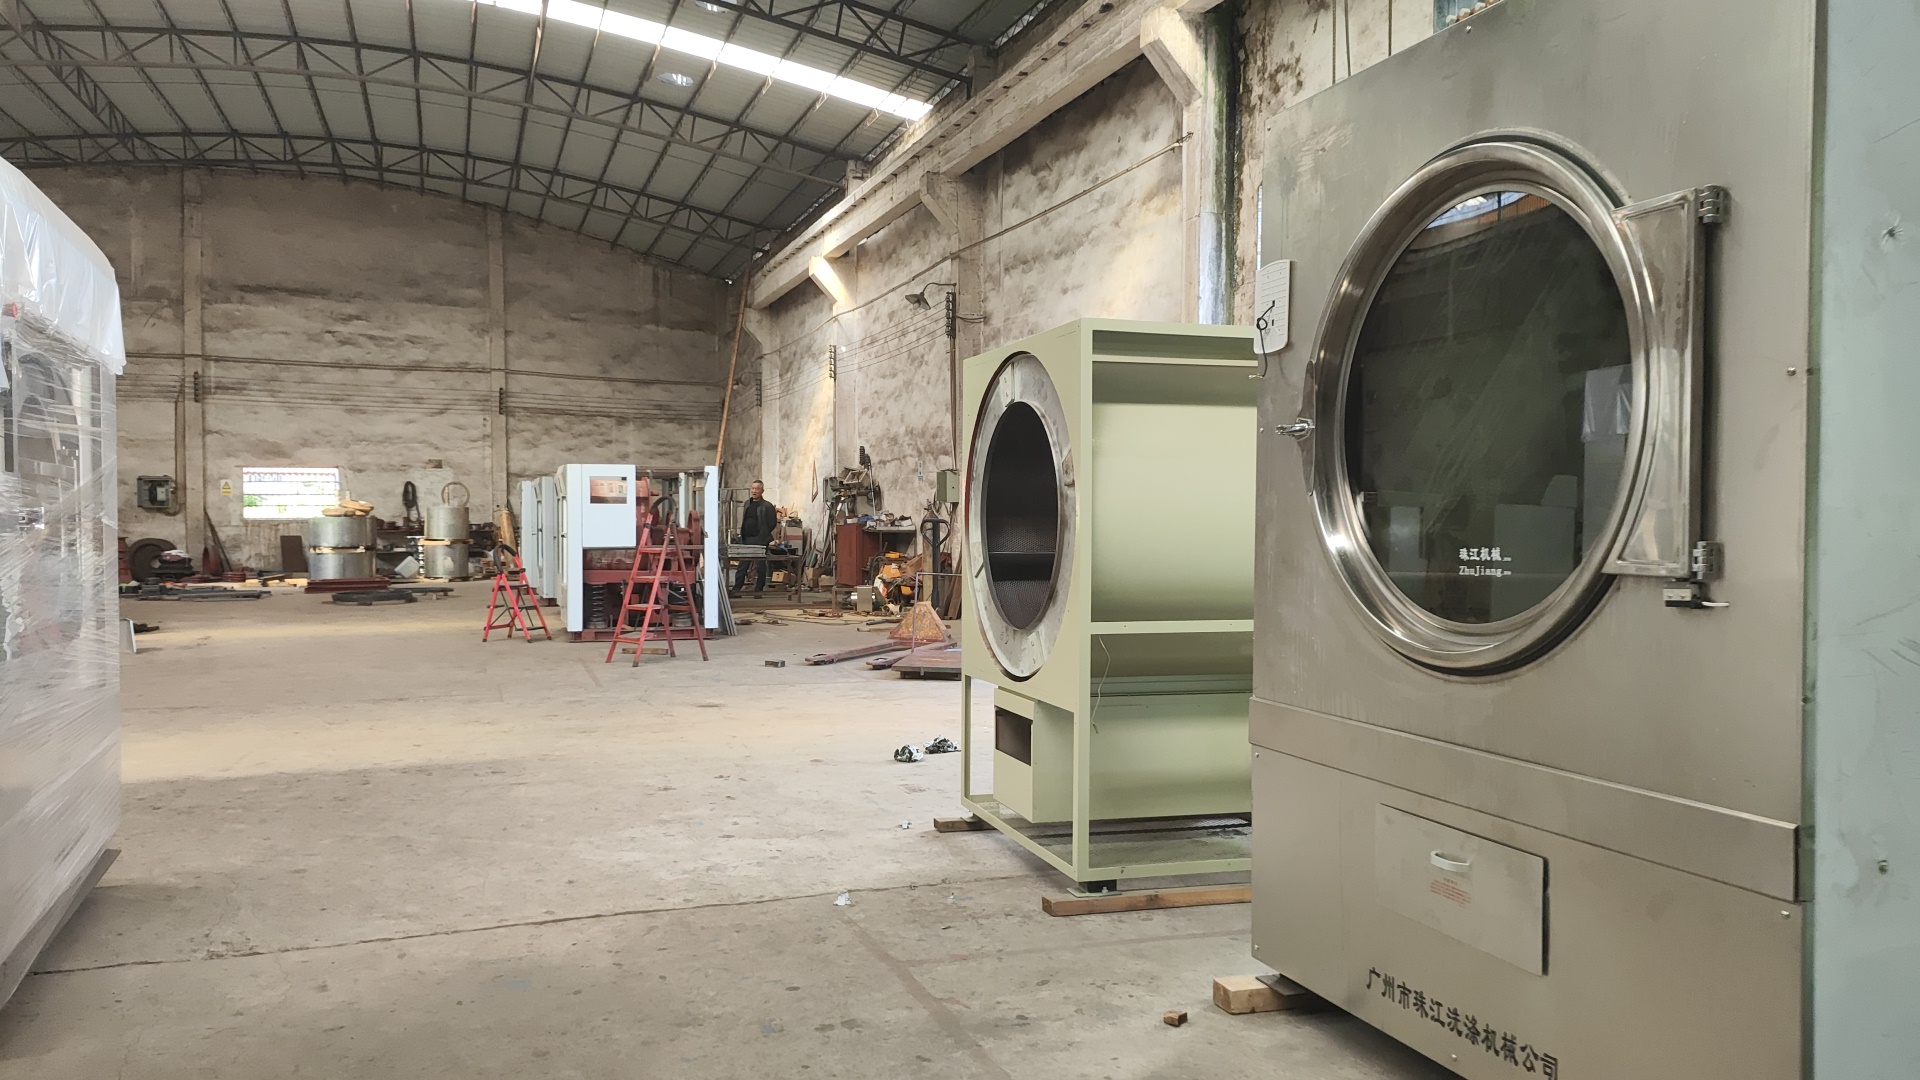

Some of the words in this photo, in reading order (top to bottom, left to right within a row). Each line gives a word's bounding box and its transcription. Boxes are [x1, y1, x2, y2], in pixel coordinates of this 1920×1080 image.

[1459, 547, 1501, 561] 珠江机械
[1459, 566, 1502, 577] ZhuJiang
[1366, 967, 1558, 1080] 广州市珠江洗涤机械公司
